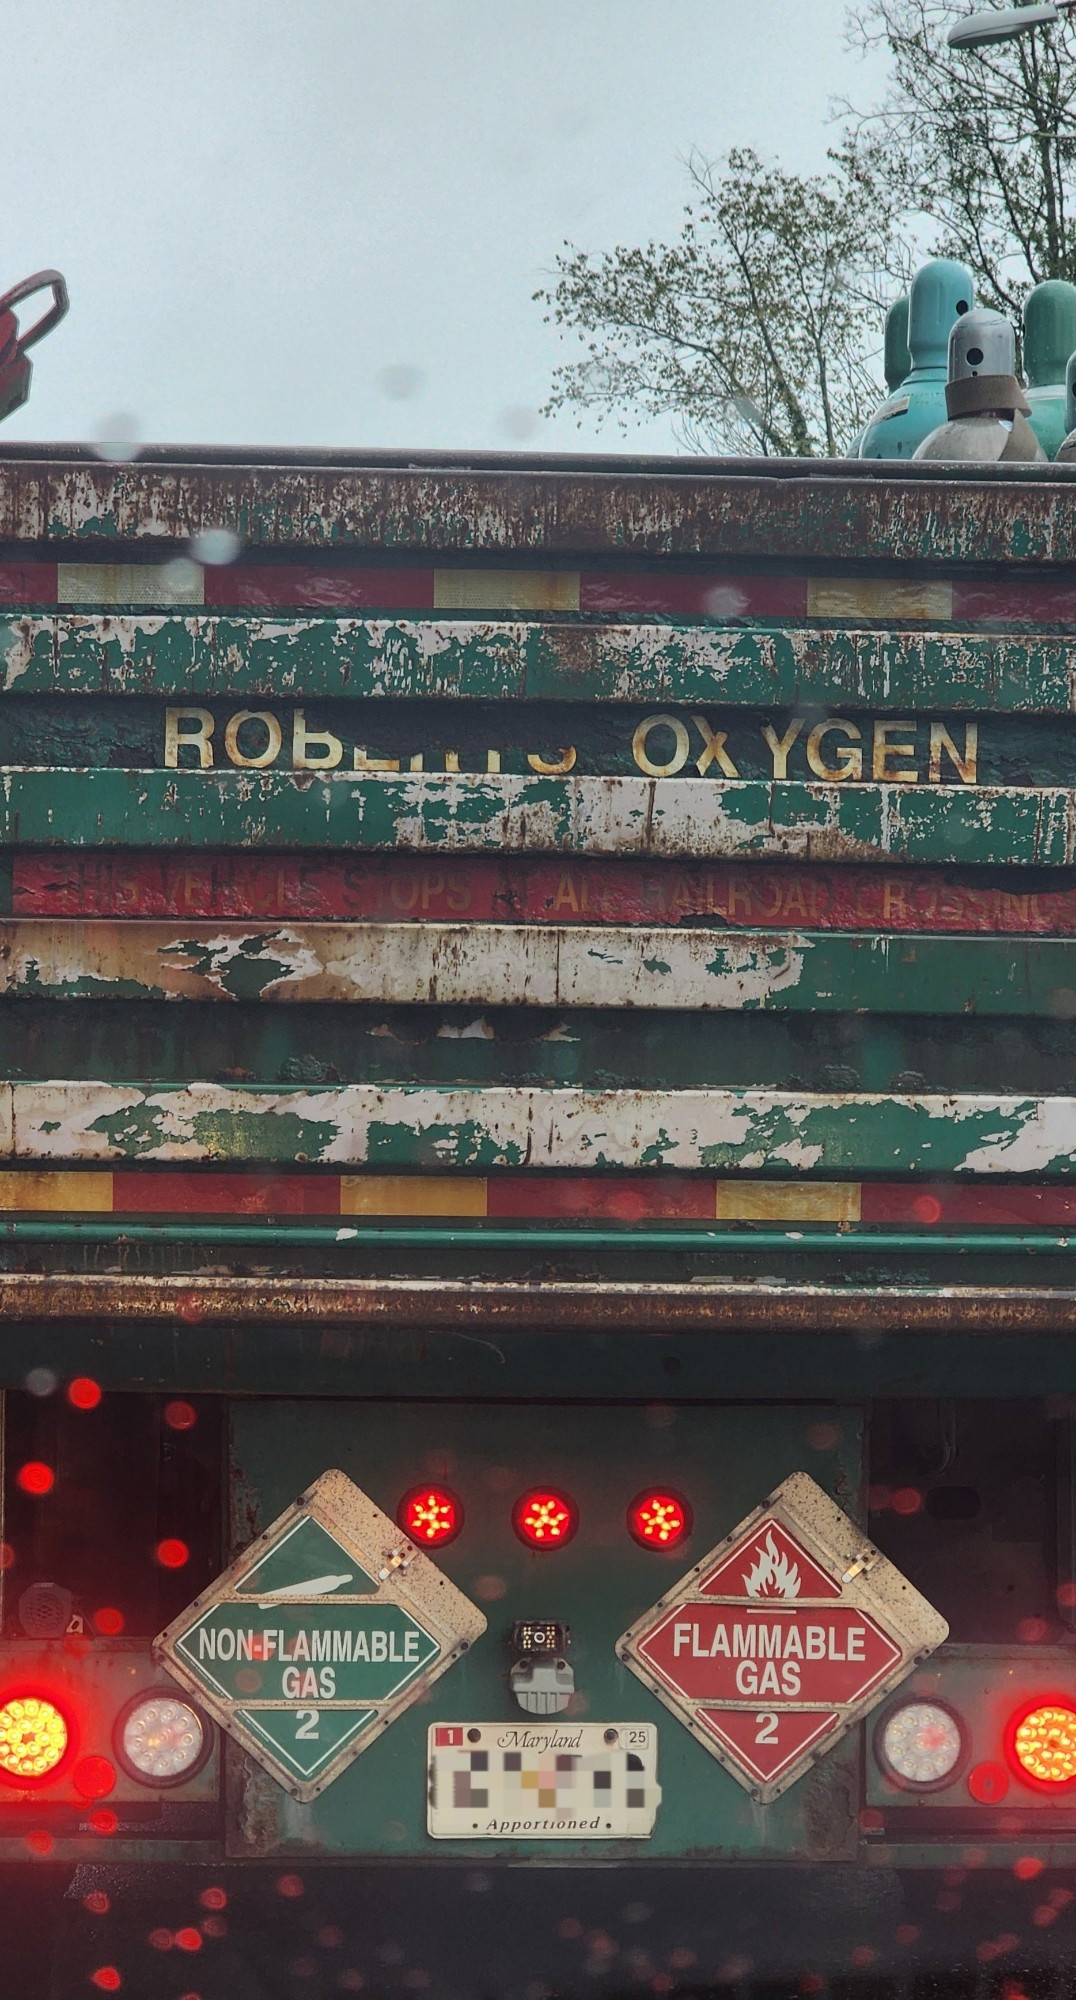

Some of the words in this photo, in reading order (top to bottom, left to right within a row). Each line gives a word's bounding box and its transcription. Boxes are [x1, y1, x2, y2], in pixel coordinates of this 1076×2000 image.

[632, 713, 978, 784] OXYGEN
[342, 865, 473, 912] STOPS
[199, 1627, 420, 1663] NON-FLAMMABLE
[673, 1622, 867, 1662] FLAMMABLE
[282, 1666, 336, 1700] GAS
[735, 1661, 802, 1696] GAS
[294, 1709, 320, 1740] 2
[446, 1729, 455, 1745] 1
[629, 1731, 646, 1744] 25
[754, 1712, 779, 1745] 2
[497, 1729, 583, 1754] Maryland
[486, 1816, 601, 1833] Apportioned
